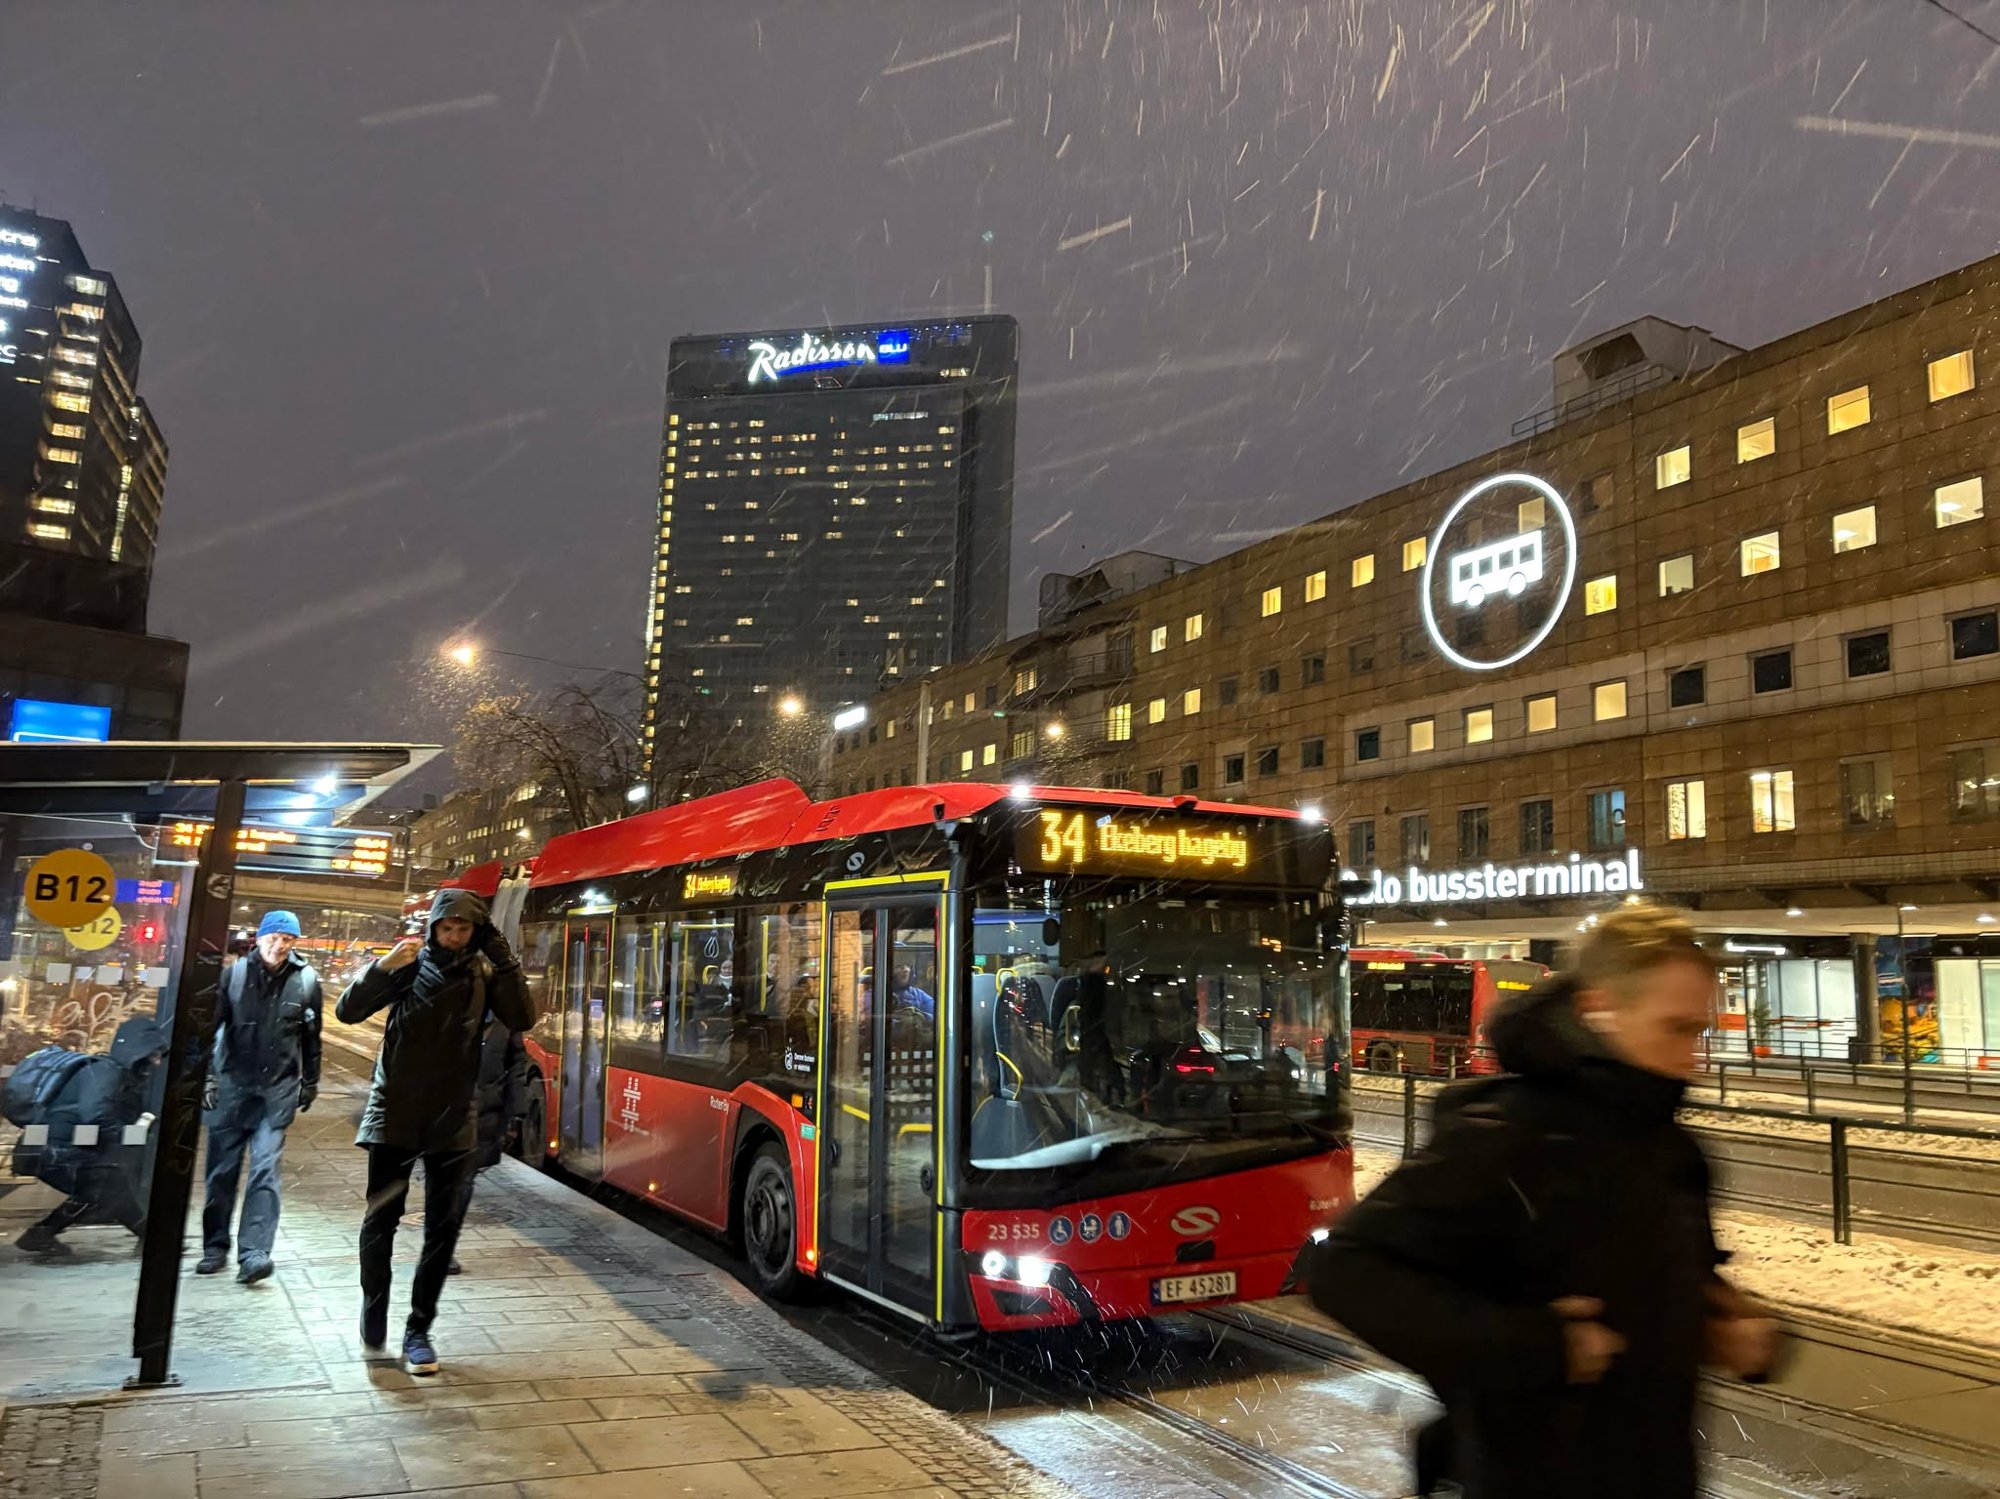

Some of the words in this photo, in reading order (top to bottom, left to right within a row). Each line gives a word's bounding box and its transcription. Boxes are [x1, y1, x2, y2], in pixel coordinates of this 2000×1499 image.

[747, 332, 876, 382] Radisson
[1041, 812, 1084, 863] 34
[35, 873, 107, 904] B12
[684, 874, 697, 899] 34
[1409, 848, 1643, 902] bussterminal
[988, 1224, 1009, 1240] 23
[1012, 1223, 1040, 1239] 535
[1166, 1282, 1184, 1298] EF
[1189, 1275, 1232, 1295] 45281
